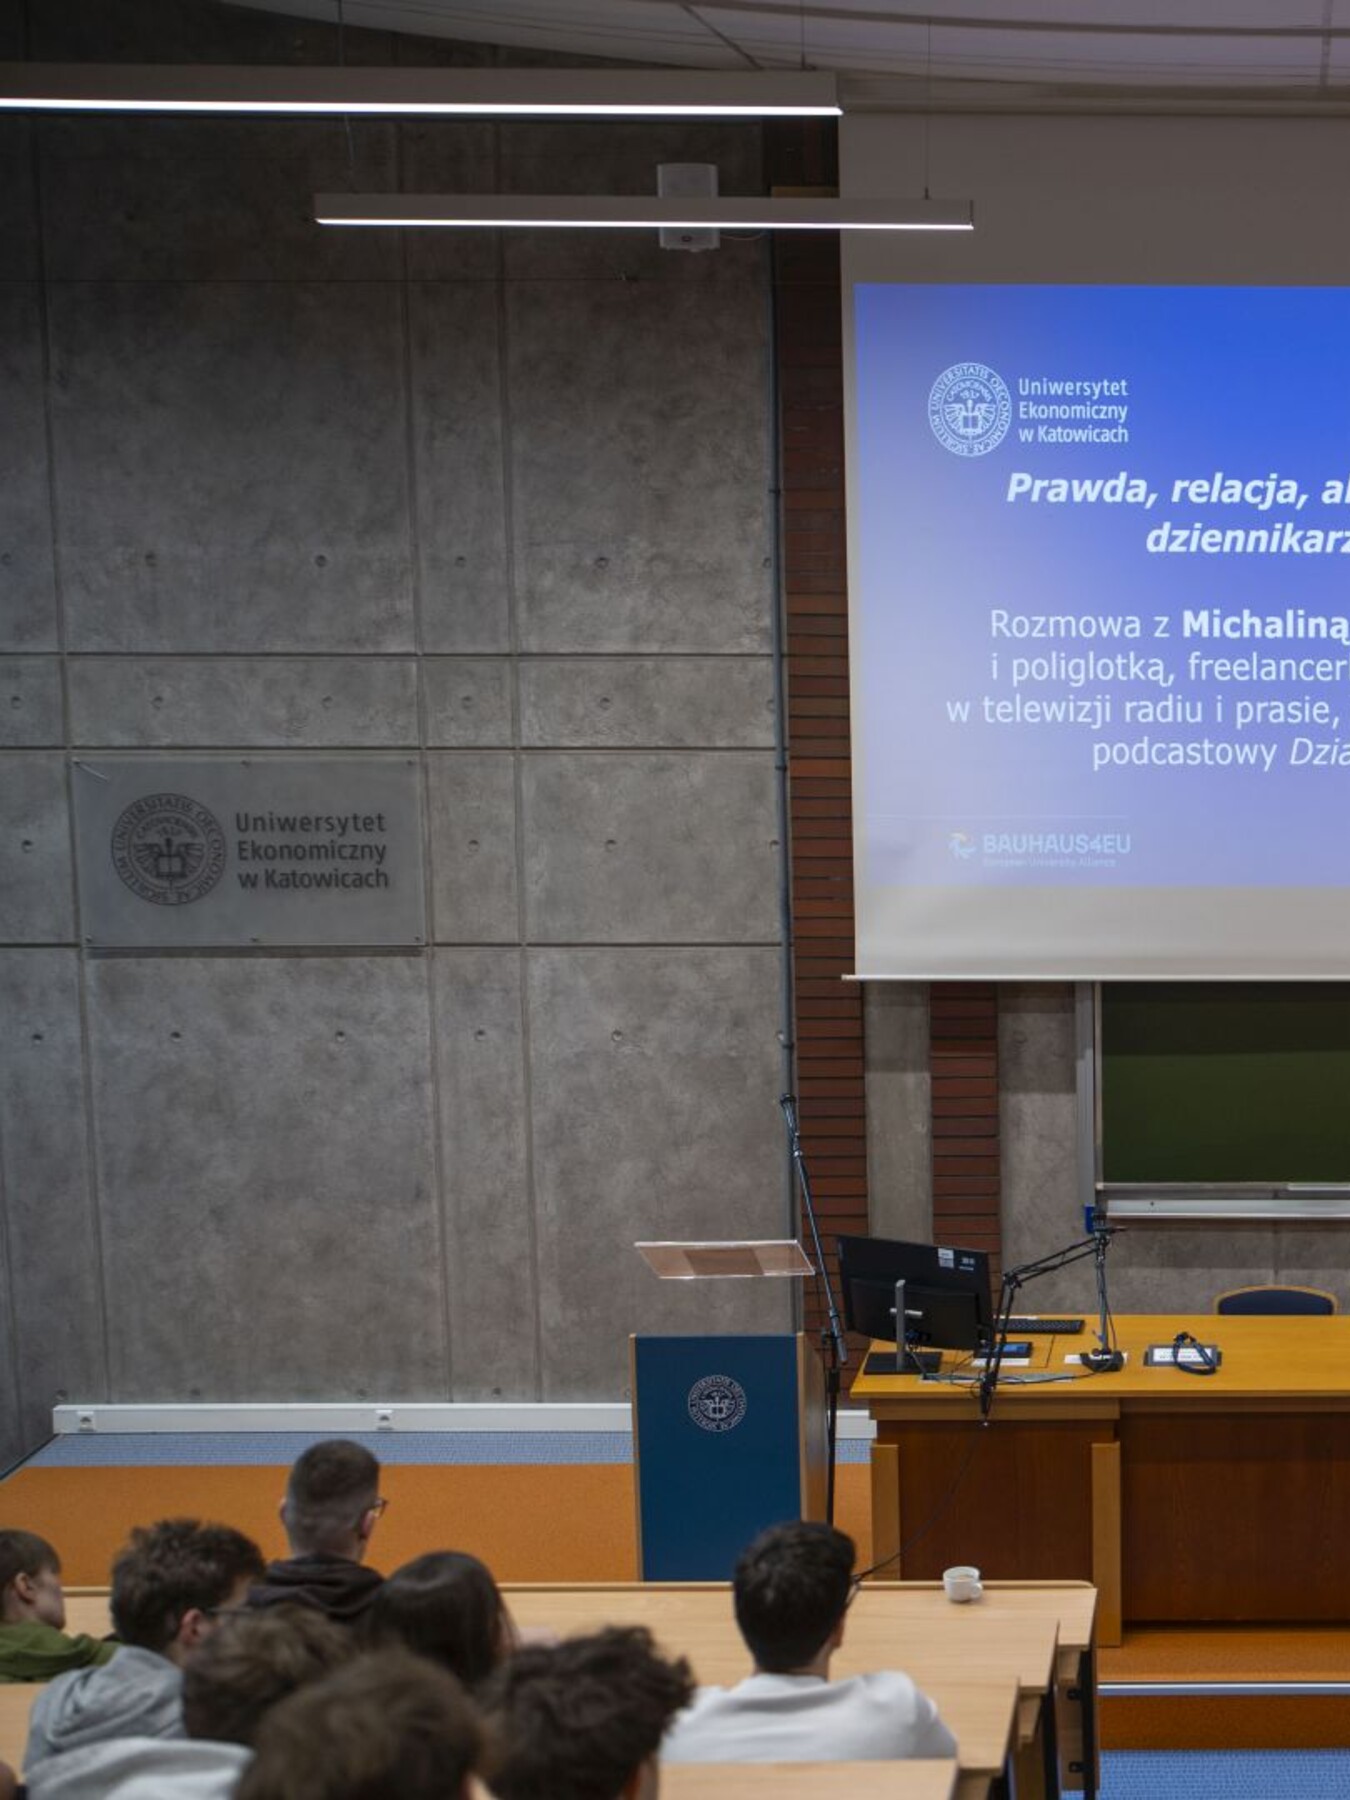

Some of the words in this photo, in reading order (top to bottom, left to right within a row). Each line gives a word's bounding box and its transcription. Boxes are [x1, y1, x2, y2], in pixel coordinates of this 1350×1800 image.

[1019, 378, 1128, 399] Uniwersytet
[1019, 401, 1128, 423] Ekonomiczny
[1019, 428, 1033, 443] w
[1038, 425, 1128, 443] Katowicach
[1007, 472, 1158, 509] Prawda,
[1171, 472, 1308, 511] relacja,
[991, 609, 1141, 638] Rozmowa
[1153, 615, 1169, 638] z
[1182, 609, 1350, 646] Michaliną
[991, 652, 998, 681] i
[1012, 652, 1175, 687] poliglotką,
[947, 701, 969, 722] w
[983, 695, 1111, 729] telewizji
[1125, 694, 1202, 723] radiu
[1216, 696, 1223, 723] i
[1236, 696, 1339, 730] prasie,
[1093, 737, 1278, 771] podcastowy
[236, 812, 386, 836] Uniwersytet
[238, 840, 387, 864] Ekonomiczny
[983, 834, 1131, 854] BAUHAUS4EU
[238, 872, 258, 889] w
[265, 868, 388, 889] Katowicach
